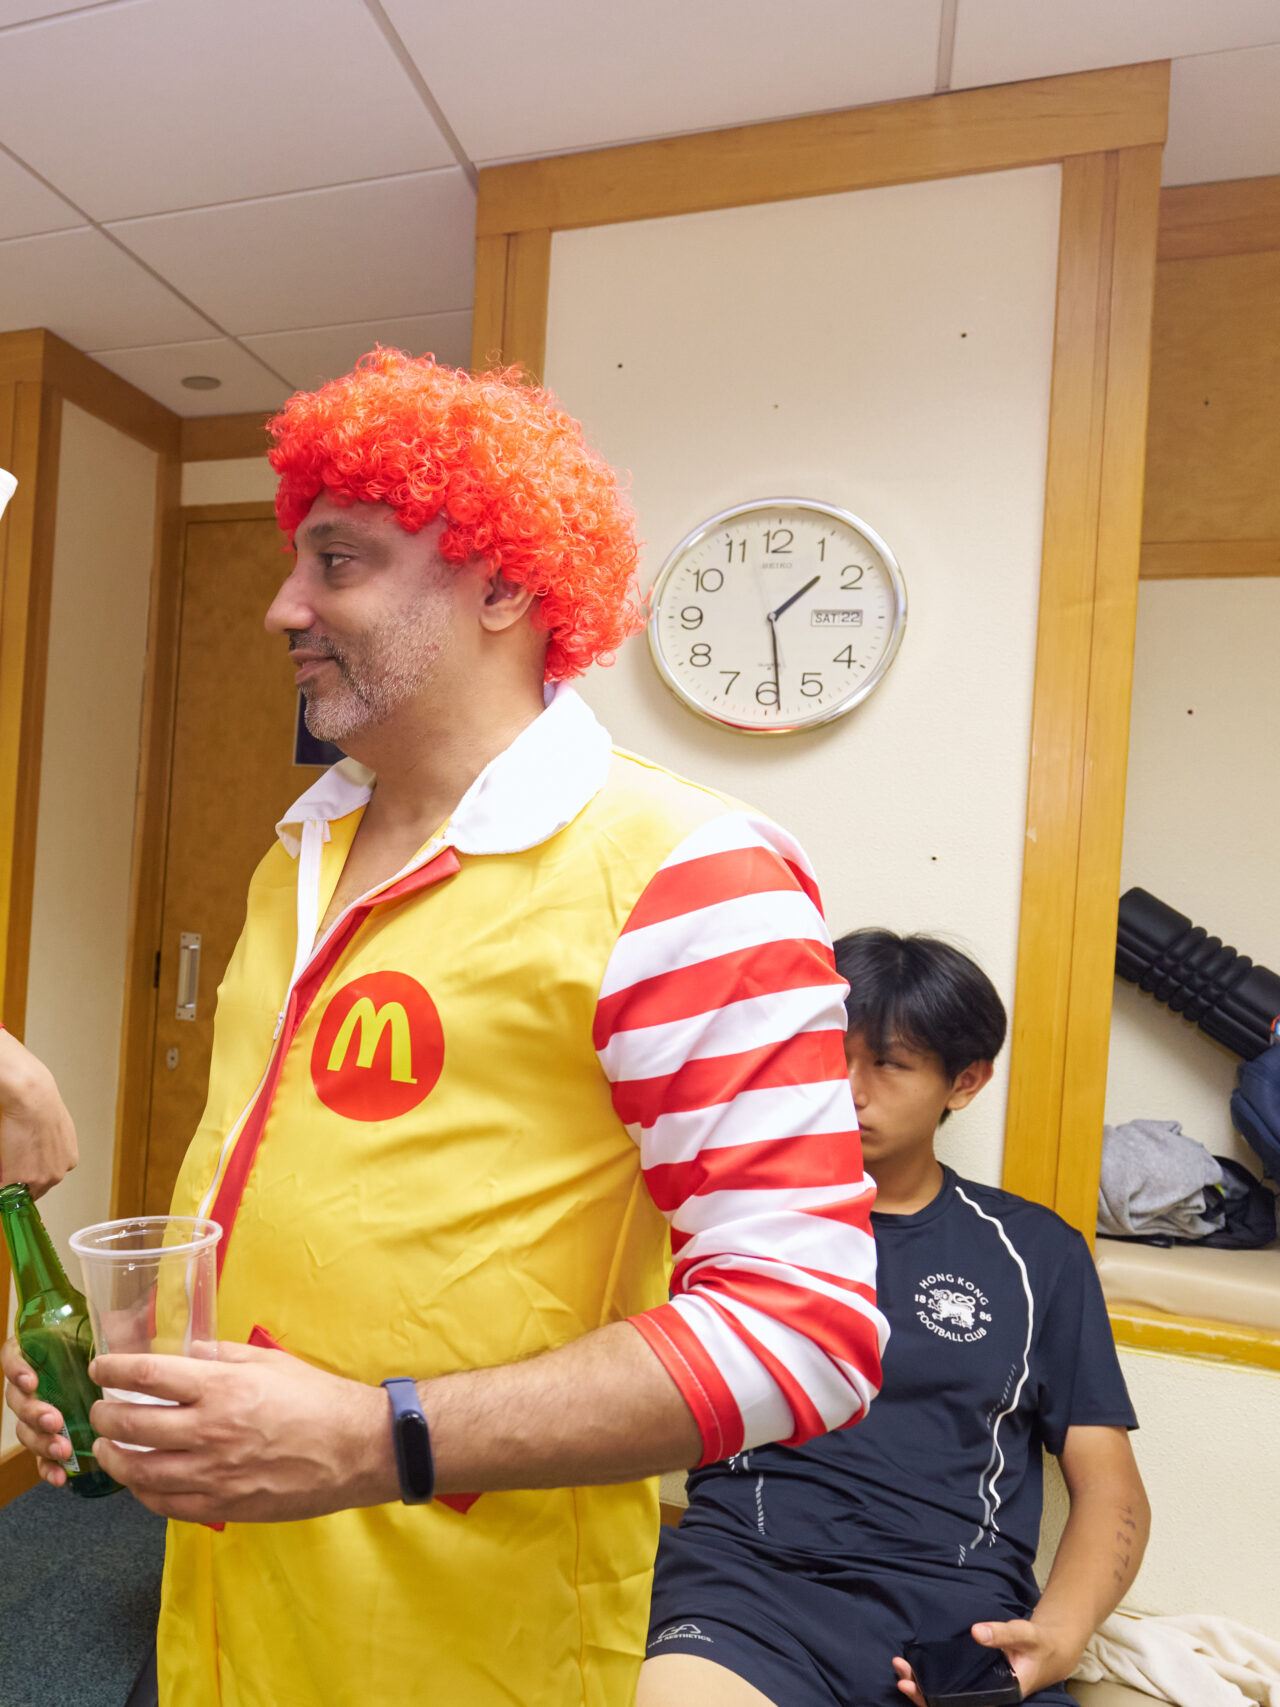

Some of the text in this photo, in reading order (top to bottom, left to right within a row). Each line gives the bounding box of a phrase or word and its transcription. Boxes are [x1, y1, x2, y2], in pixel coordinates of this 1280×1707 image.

[725, 539, 747, 563] 11
[762, 529, 794, 553] 12
[817, 537, 826, 562] 1
[692, 568, 724, 592] 10
[840, 565, 864, 590] 2
[680, 606, 703, 630] 9
[815, 611, 860, 623] SAT 22
[689, 643, 712, 667] 8
[832, 644, 856, 669] 4
[719, 671, 740, 695] 7
[755, 681, 780, 706] 6
[800, 672, 823, 697] 5
[919, 1273, 989, 1305] HONG KONG
[914, 1294, 992, 1322] 18 86
[916, 1311, 987, 1342] FOOTBALL CLUB
